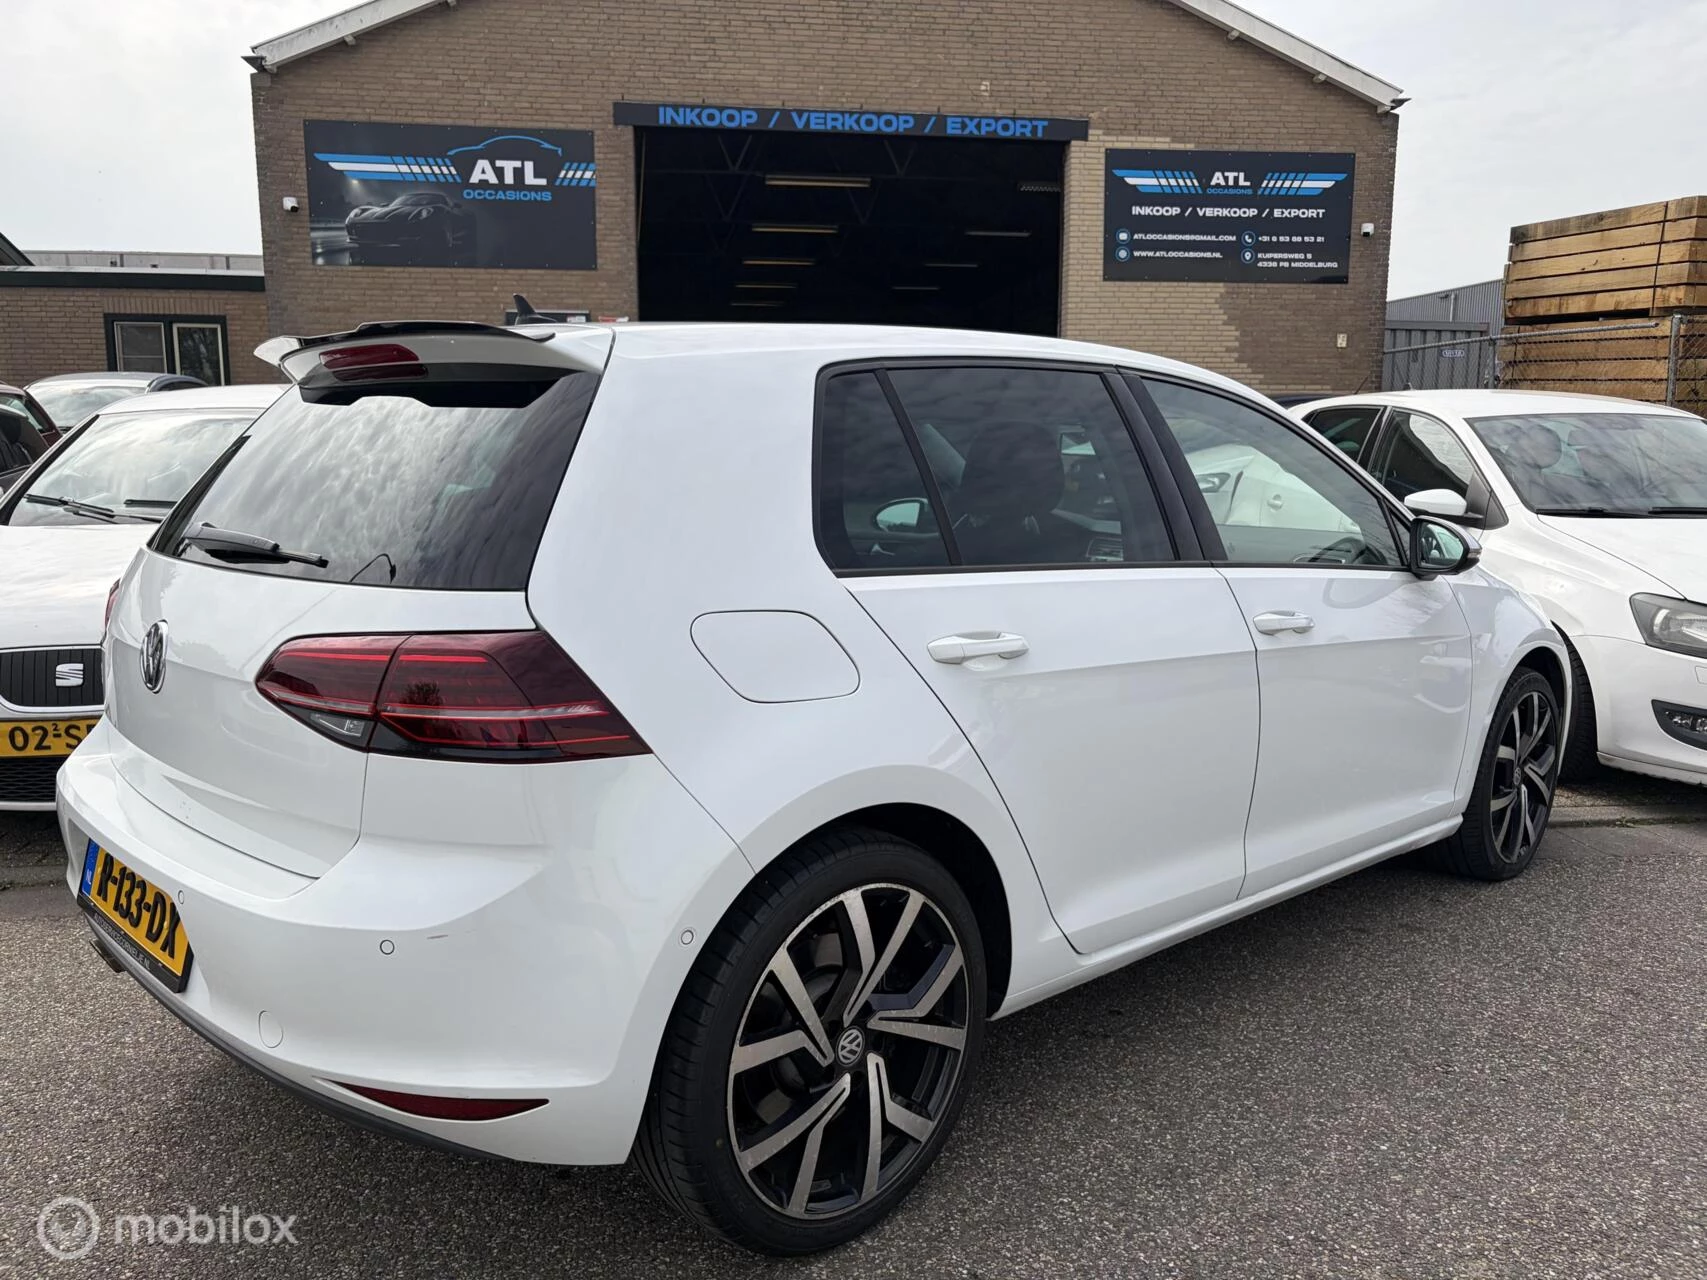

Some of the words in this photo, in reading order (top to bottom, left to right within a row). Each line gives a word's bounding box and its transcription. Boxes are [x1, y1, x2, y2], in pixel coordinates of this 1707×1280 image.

[658, 106, 758, 128] INKOOP
[769, 111, 780, 128] /
[791, 111, 914, 133] VERKOOP
[924, 116, 937, 133] /
[946, 117, 1048, 138] EXPORT
[469, 159, 547, 185] ATL
[1210, 171, 1251, 186] ATL
[463, 189, 552, 201] OCCASIONS
[1132, 206, 1181, 216] INKOOP
[1197, 207, 1258, 218] VERKOOP
[1273, 208, 1326, 218] EXPORT
